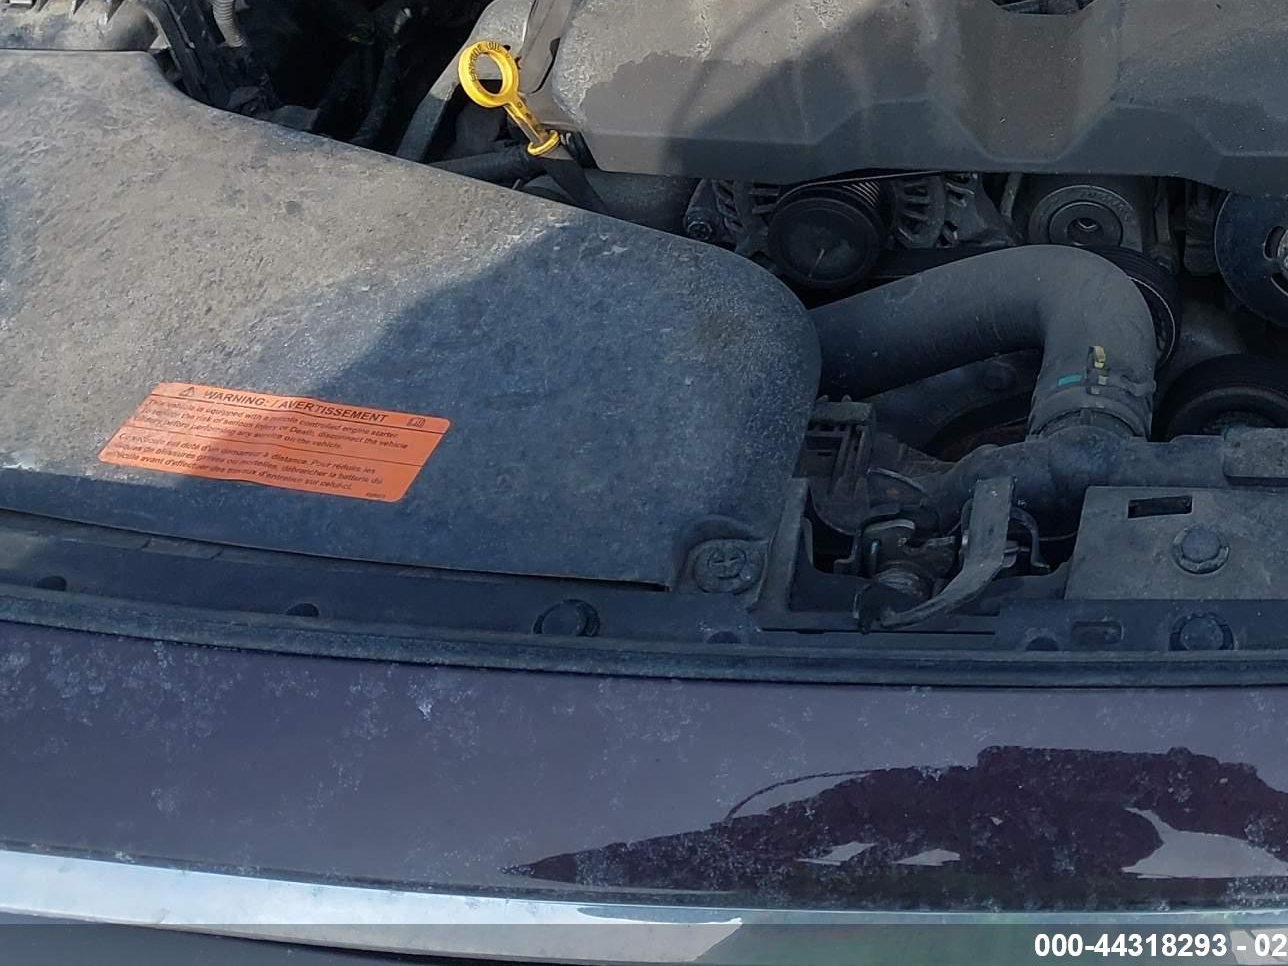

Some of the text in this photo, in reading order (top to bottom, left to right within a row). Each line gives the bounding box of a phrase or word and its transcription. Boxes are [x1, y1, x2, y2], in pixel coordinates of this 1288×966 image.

[487, 41, 501, 51] OIL
[205, 389, 268, 408] WARNING:
[279, 400, 390, 423] AVERTISSEMENT
[194, 413, 211, 423] risk
[223, 418, 253, 428] serious
[206, 405, 244, 419] equipped
[246, 410, 261, 419] with
[300, 419, 341, 431] controlled
[140, 455, 163, 465] avant
